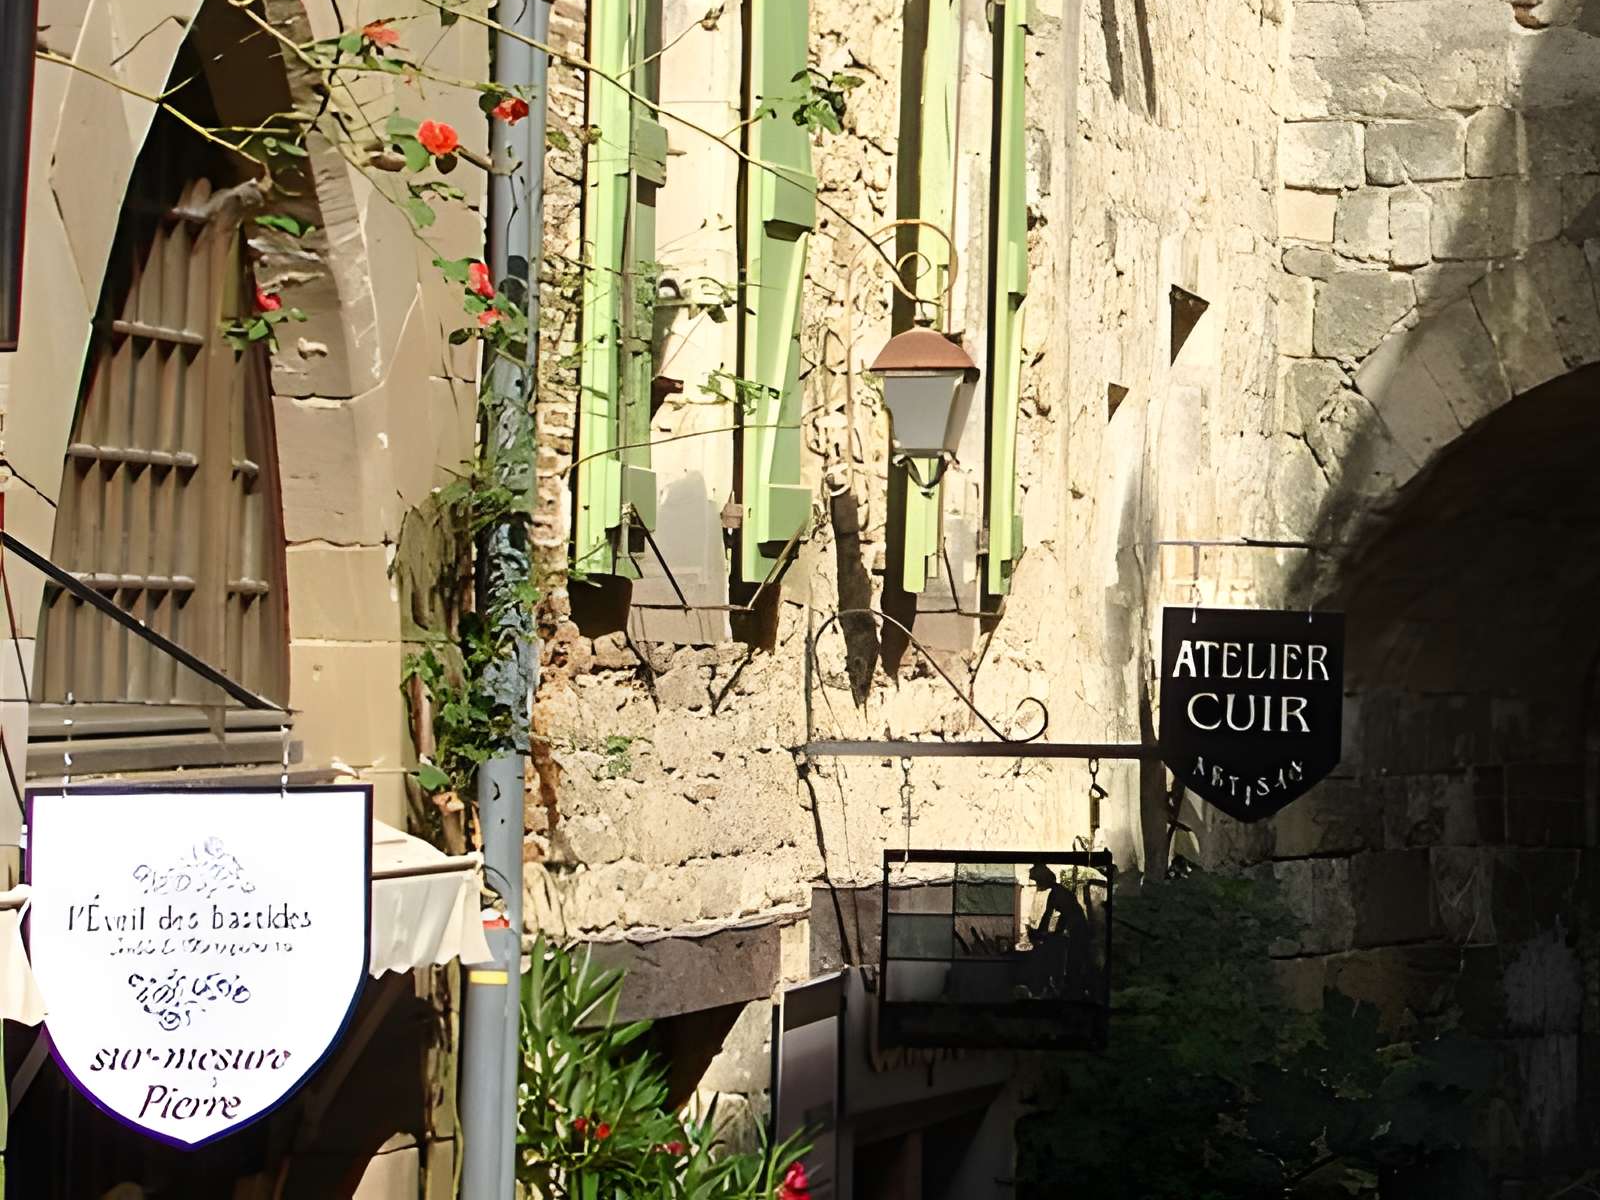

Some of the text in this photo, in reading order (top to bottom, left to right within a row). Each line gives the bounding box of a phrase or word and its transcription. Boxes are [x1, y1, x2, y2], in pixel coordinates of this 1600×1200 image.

[1172, 639, 1329, 681] ATELIER
[1187, 692, 1311, 733] CUIR
[1192, 755, 1304, 807] ARTISAN
[138, 1084, 242, 1120] Pierre
